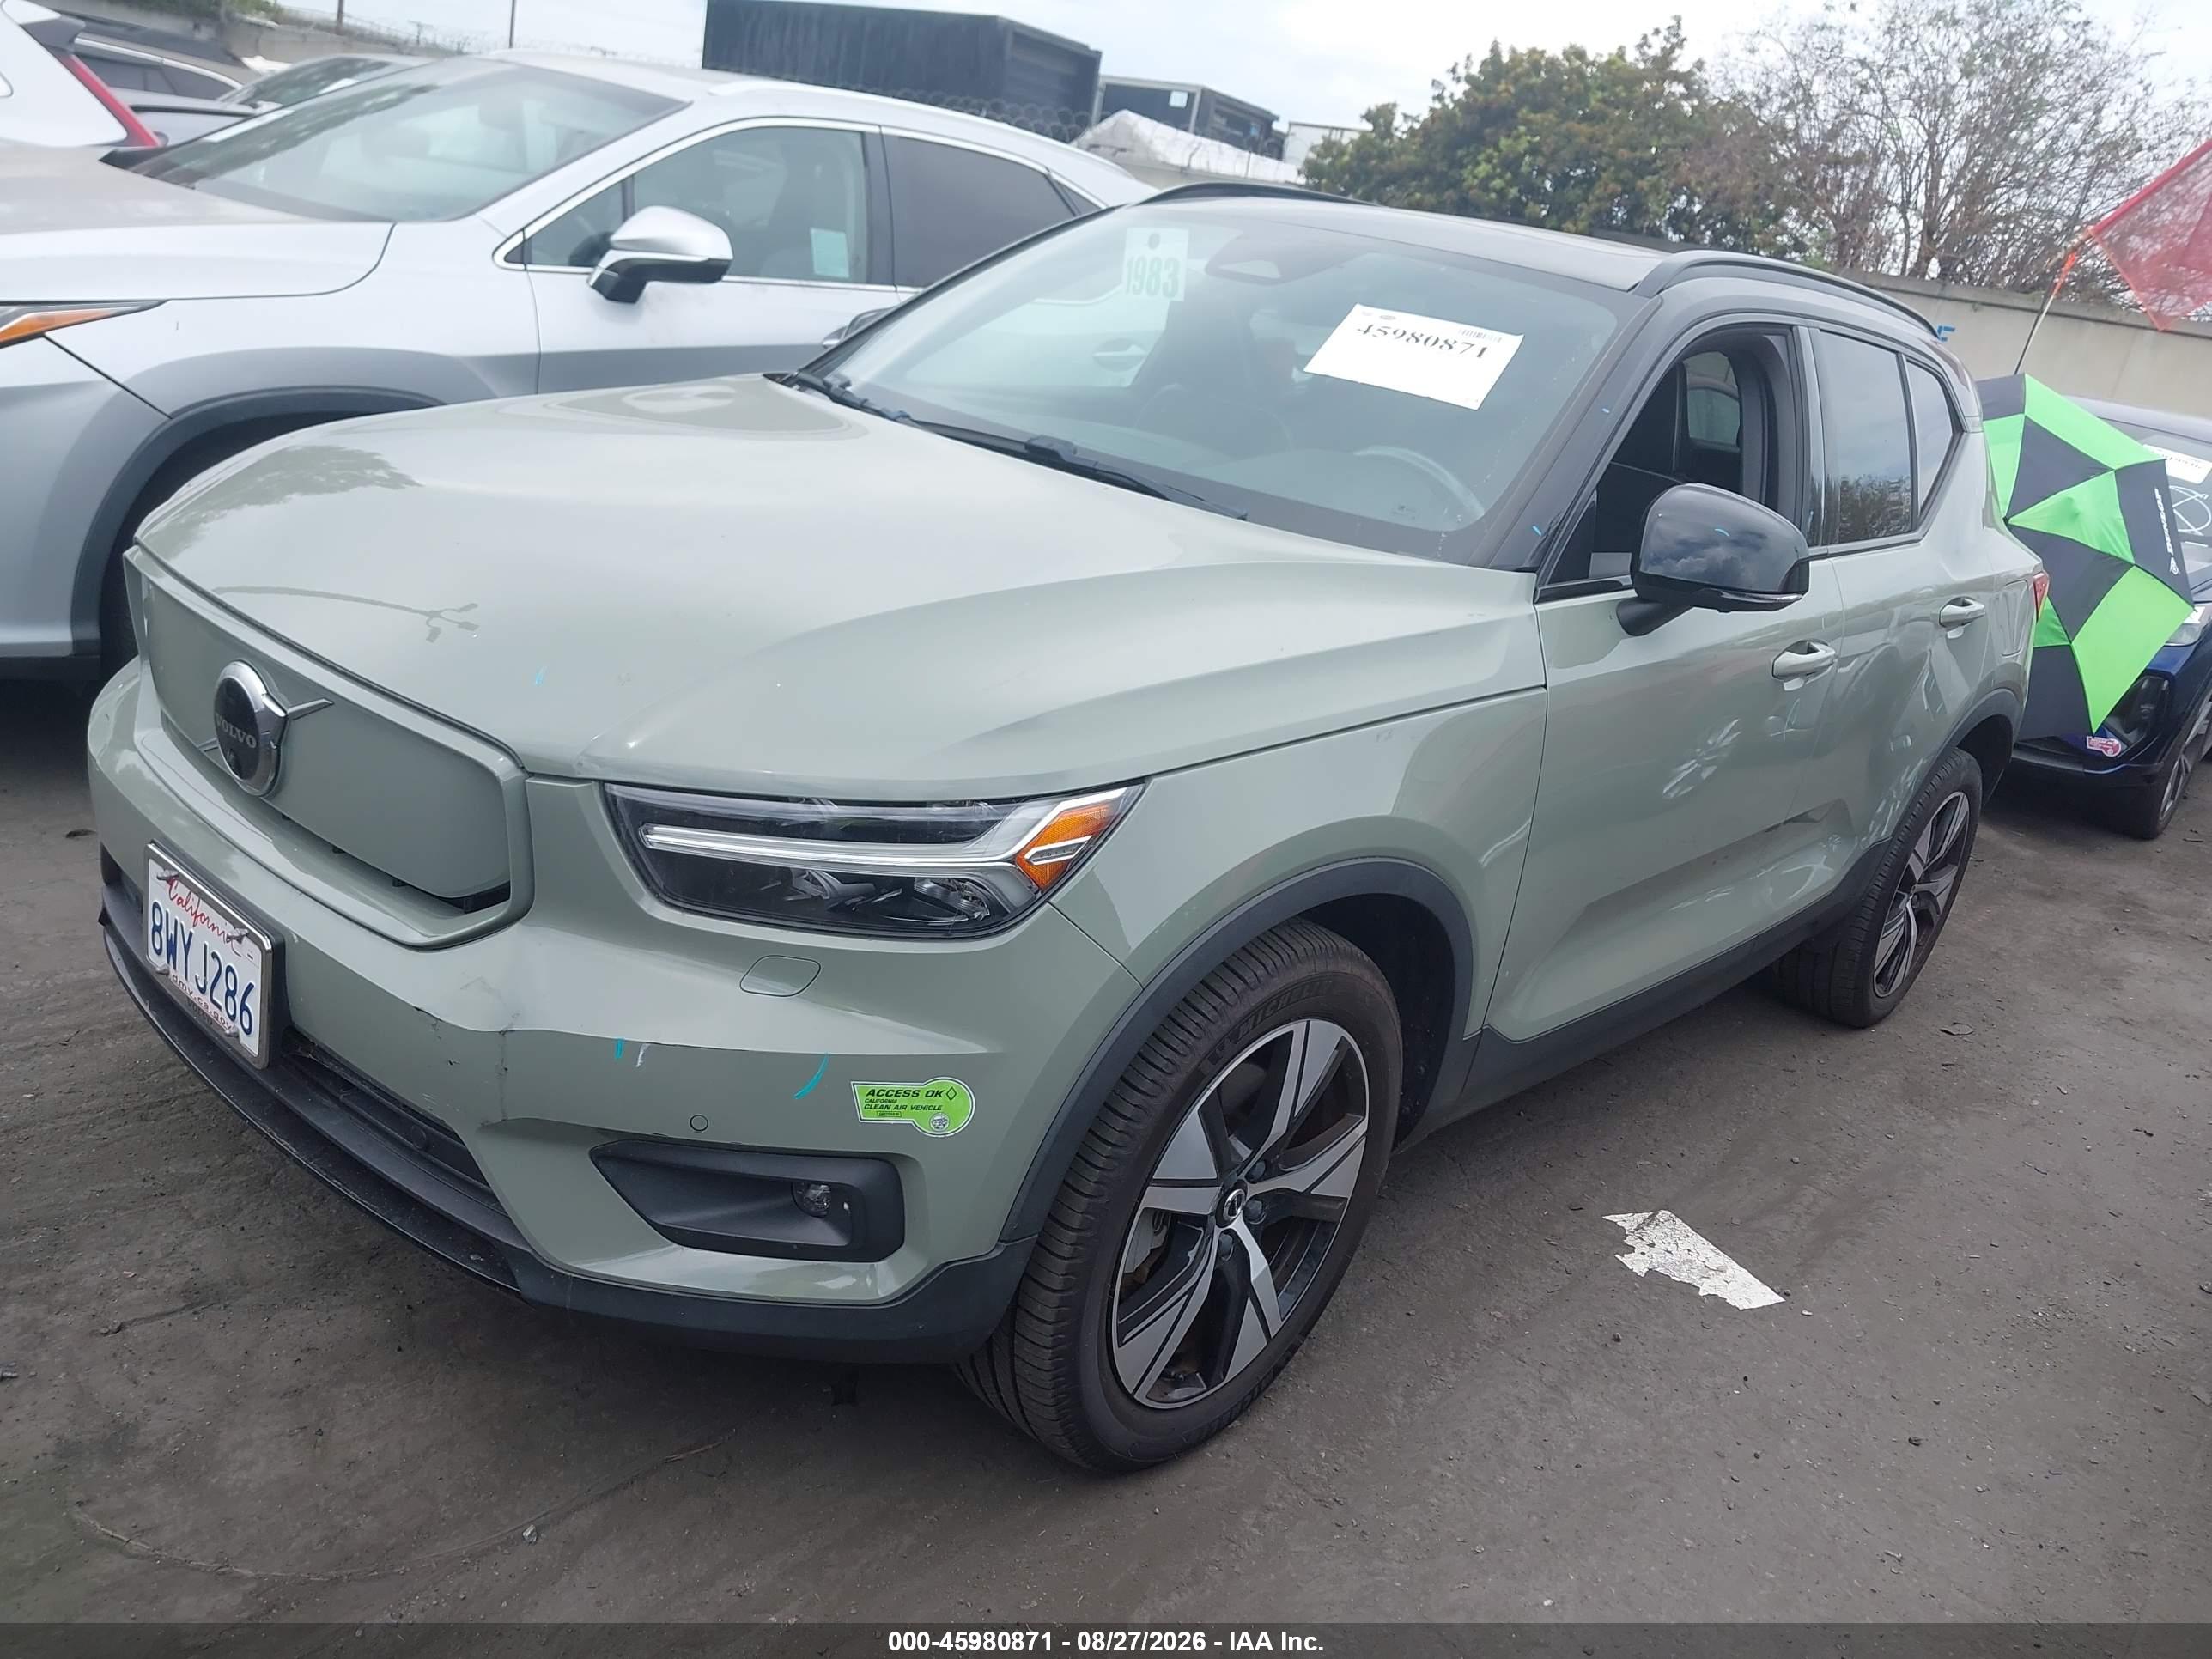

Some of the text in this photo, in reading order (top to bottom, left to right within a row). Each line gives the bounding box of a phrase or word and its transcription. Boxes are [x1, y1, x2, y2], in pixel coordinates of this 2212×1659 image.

[1126, 257, 1181, 298] 1983
[1356, 324, 1488, 358] 45980871
[216, 713, 257, 749] VOLVO
[151, 901, 255, 1036] 8WYJ286
[172, 974, 232, 1029] dmv.ca.gov
[866, 1089, 945, 1098] ACCESS OK
